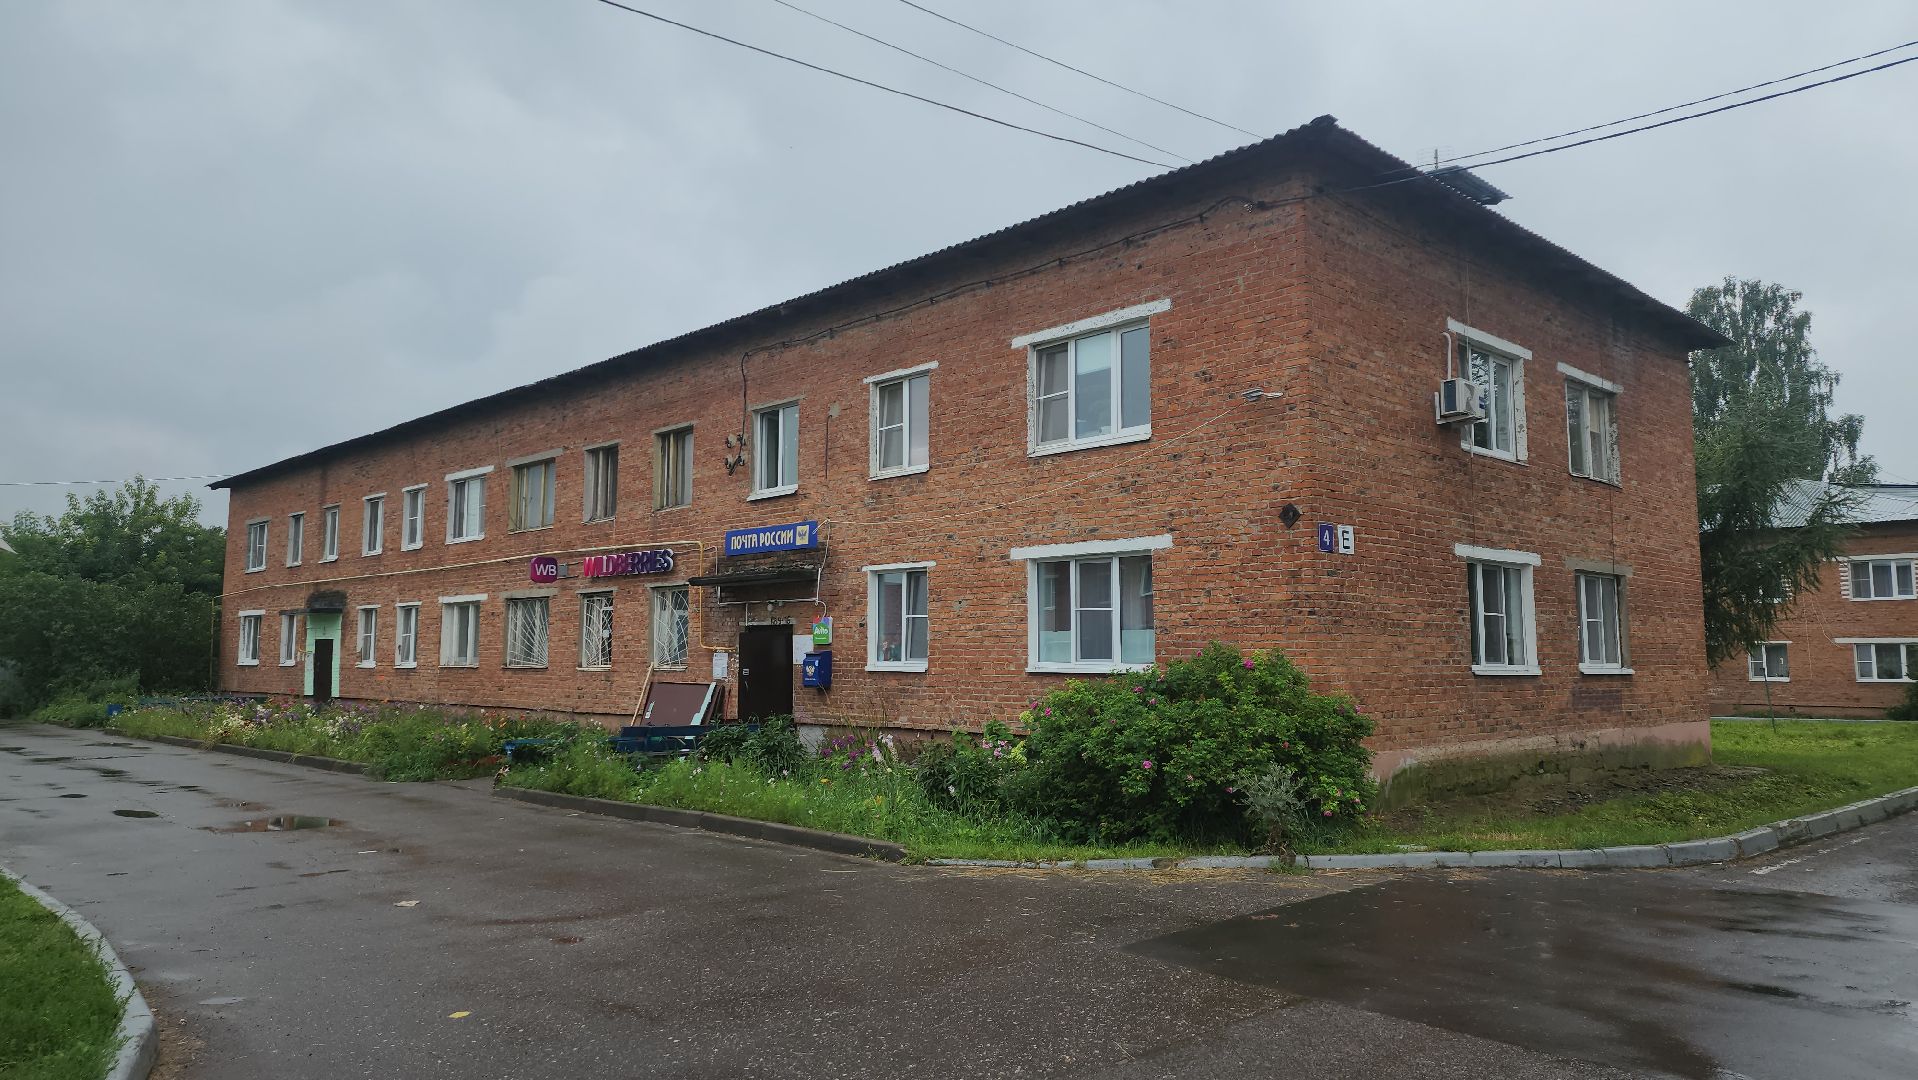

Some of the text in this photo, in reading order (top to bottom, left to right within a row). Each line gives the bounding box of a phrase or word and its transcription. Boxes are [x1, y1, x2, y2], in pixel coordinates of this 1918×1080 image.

[731, 528, 794, 550] ПОЧТА РОССИИ
[1323, 529, 1330, 546] 4
[535, 563, 557, 576] WB
[583, 548, 674, 577] WILDBERRIES
